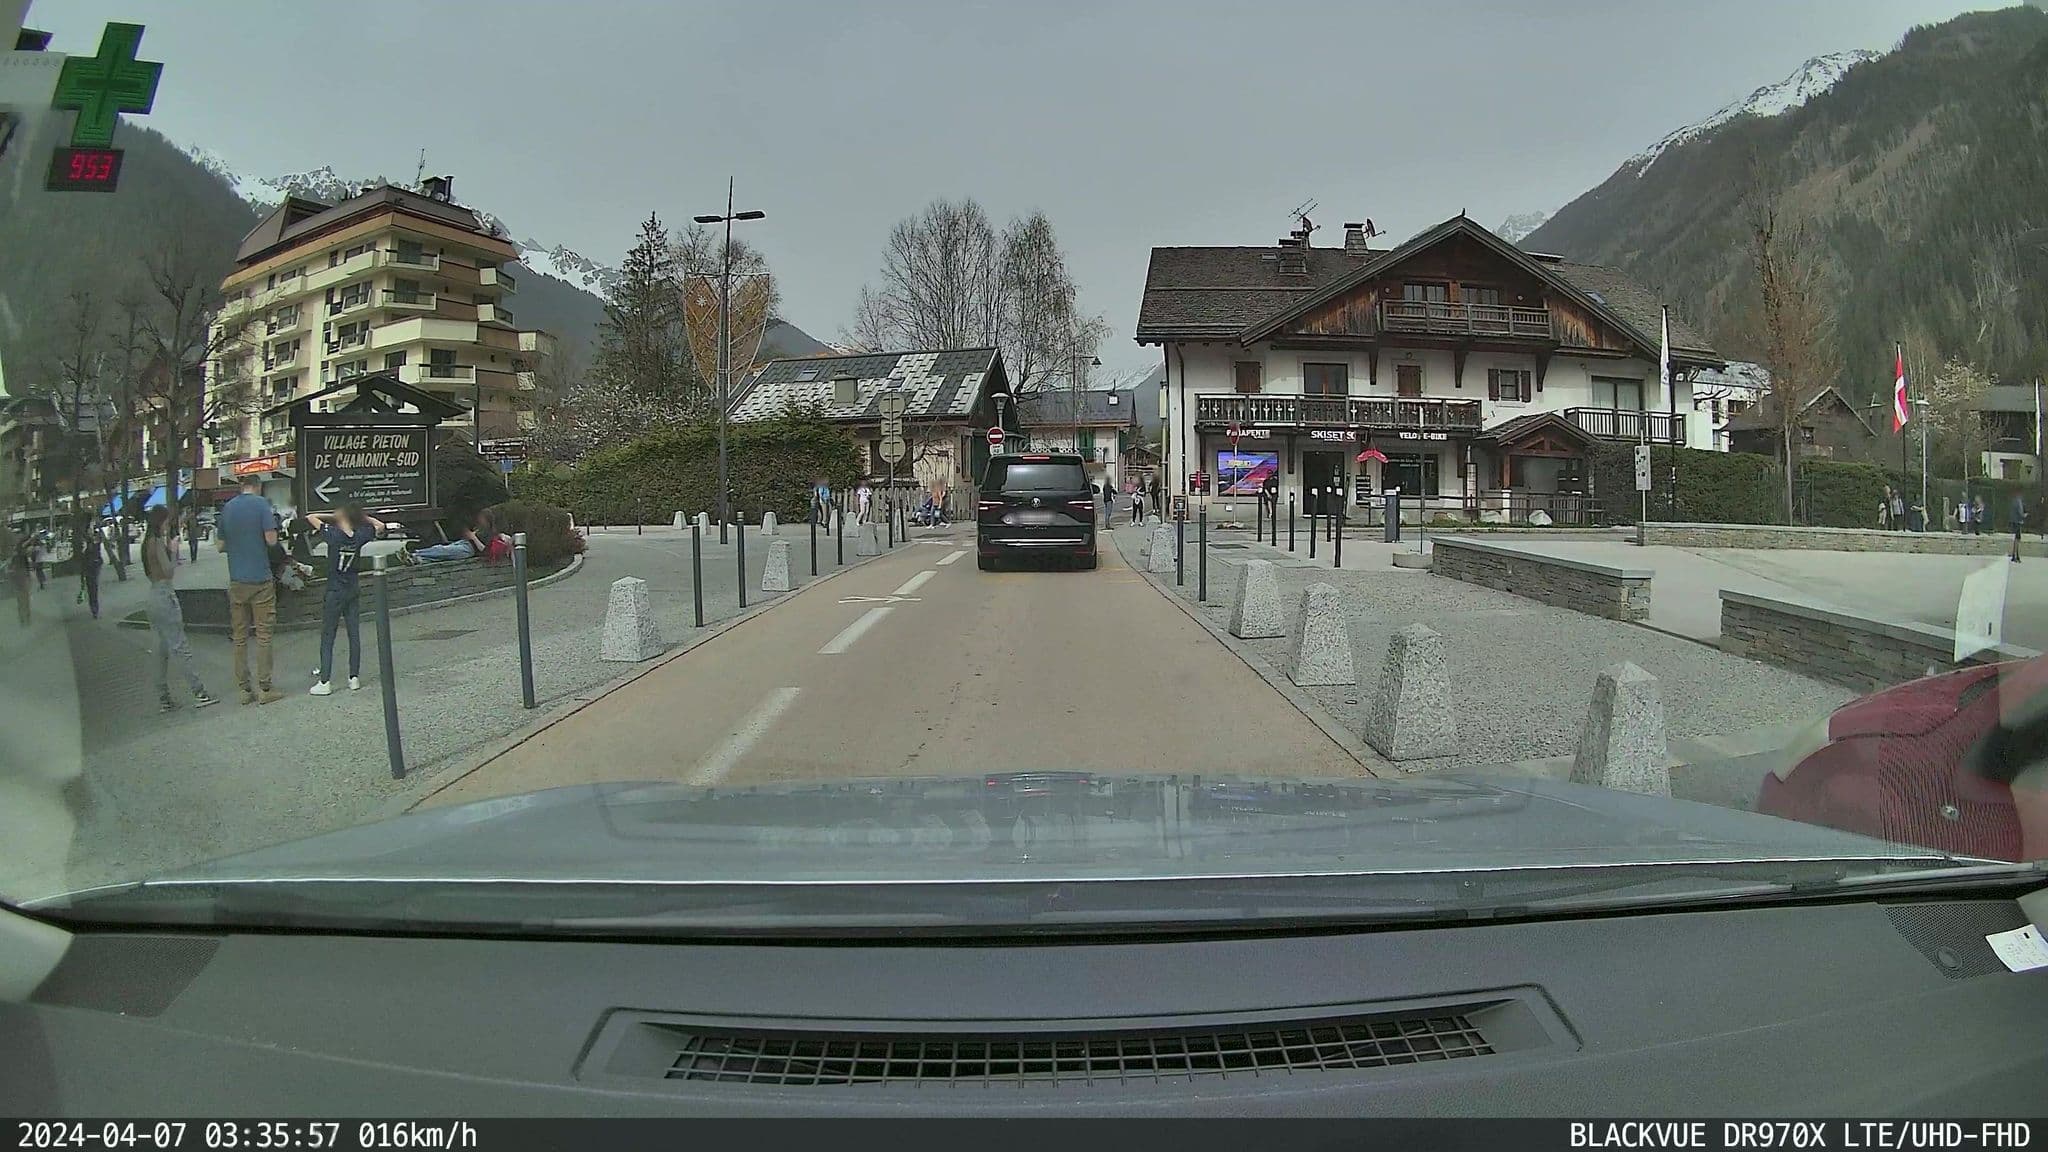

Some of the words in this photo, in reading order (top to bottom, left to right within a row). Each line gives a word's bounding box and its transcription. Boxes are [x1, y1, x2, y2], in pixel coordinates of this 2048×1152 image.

[69, 152, 114, 181] 953
[324, 435, 368, 450] VILLAGE
[372, 434, 410, 449] PIETON
[1311, 430, 1345, 439] SKISET
[315, 454, 332, 469] DE
[335, 452, 420, 468] CHAMONIX-SUD
[339, 551, 356, 573] 17
